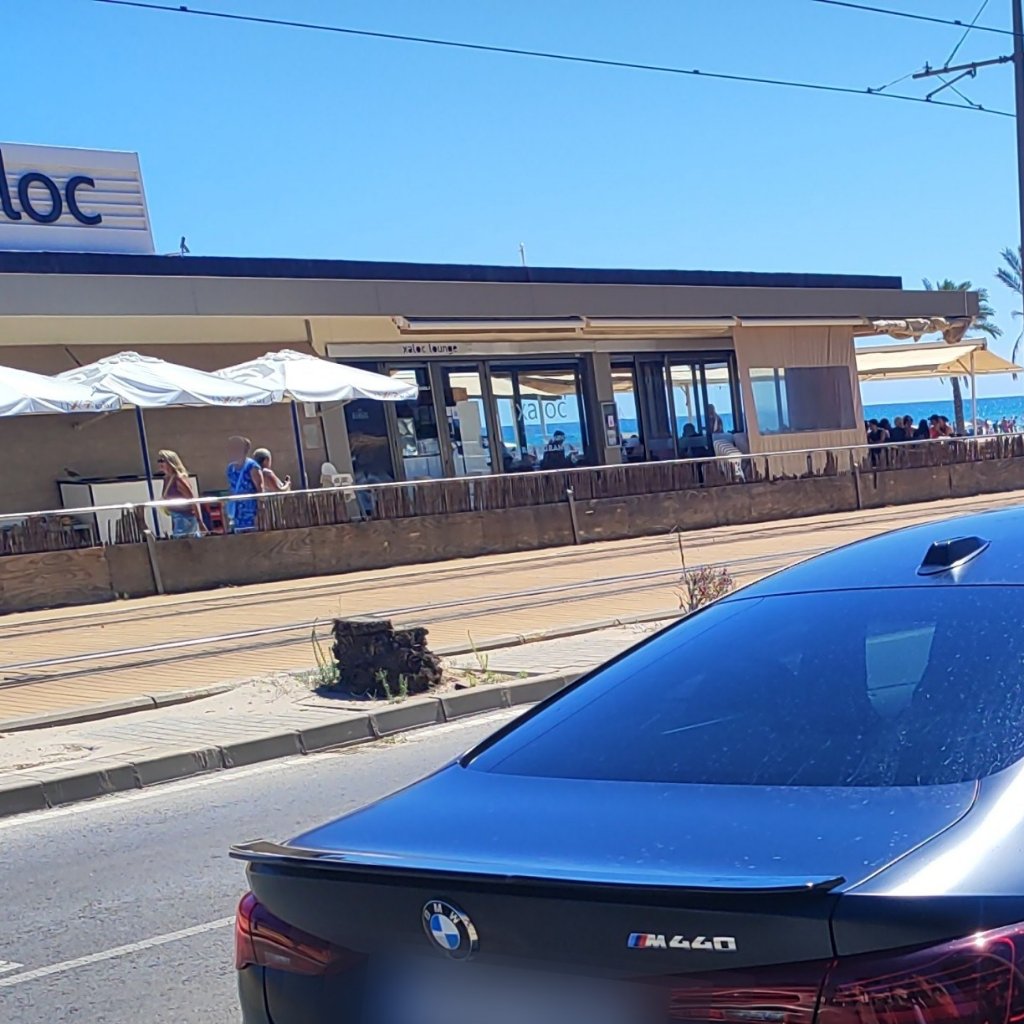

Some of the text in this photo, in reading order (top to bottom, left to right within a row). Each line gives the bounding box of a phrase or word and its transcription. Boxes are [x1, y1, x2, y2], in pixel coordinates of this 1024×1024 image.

[402, 343, 458, 354] xaloc lounge
[516, 401, 567, 421] xaoc
[424, 902, 461, 924] BMW
[645, 933, 737, 952] M440
